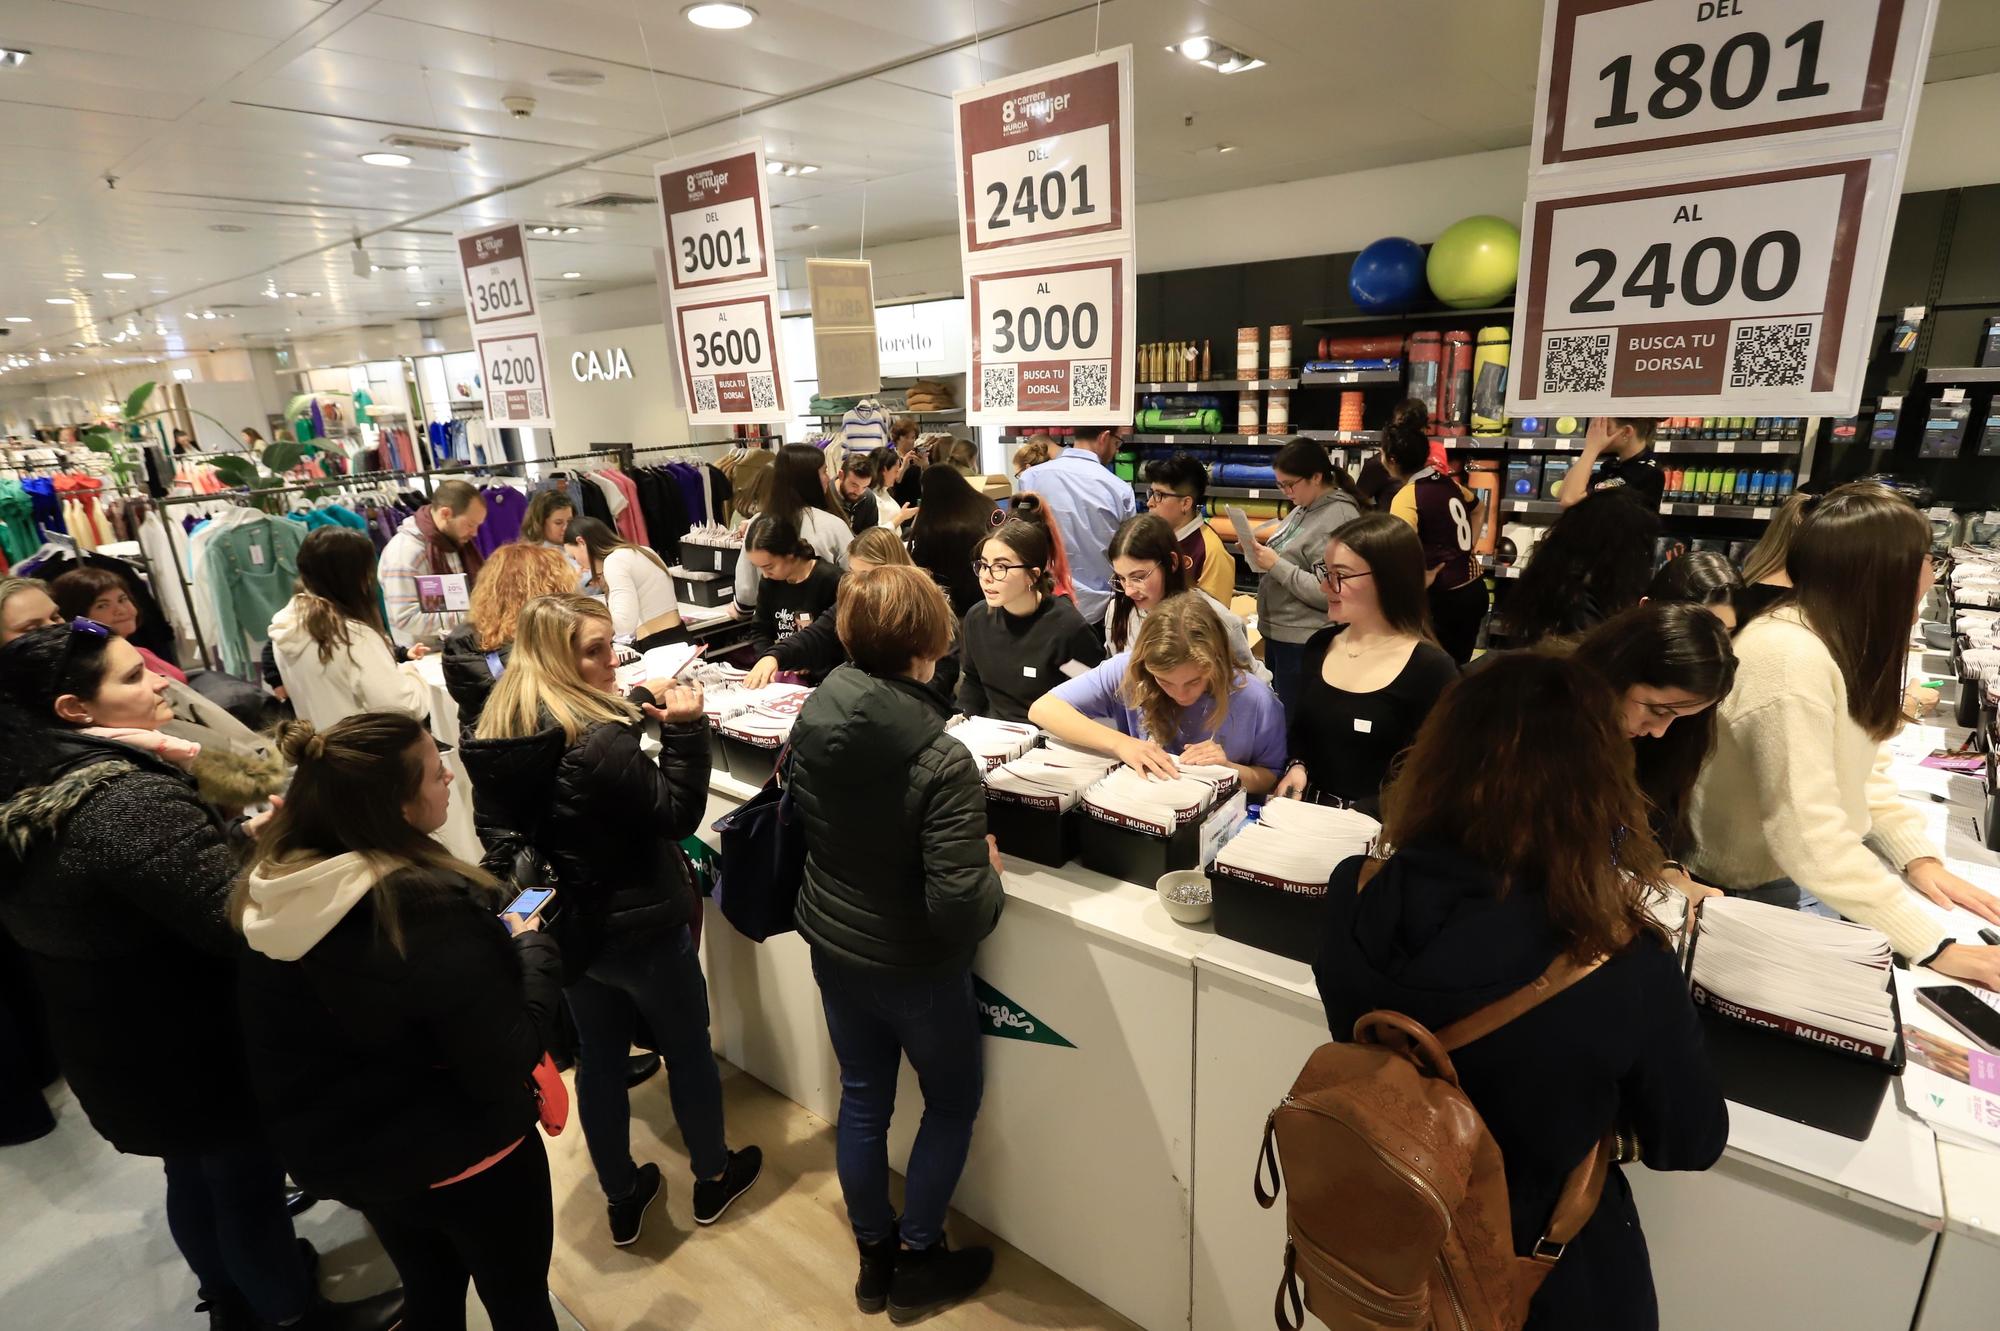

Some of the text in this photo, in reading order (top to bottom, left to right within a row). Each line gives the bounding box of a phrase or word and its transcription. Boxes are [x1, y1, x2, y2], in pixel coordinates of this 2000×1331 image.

[1697, 0, 1743, 22] DEL
[1594, 20, 1830, 129] 1801
[1017, 91, 1046, 106] carrera
[1026, 93, 1071, 123] mujer
[1003, 120, 1028, 132] MURCIA
[1028, 148, 1049, 162] DEL
[701, 172, 729, 194] mujer
[986, 164, 1096, 230] 2401
[705, 212, 719, 223] DEL
[1673, 204, 1703, 223] AL
[681, 226, 751, 273] 3001
[1569, 230, 1801, 314] 2400
[477, 278, 523, 312] 3601
[1036, 282, 1051, 294] AL
[718, 312, 727, 322] AL
[992, 301, 1099, 354] 3000
[693, 327, 761, 368] 3600
[1629, 333, 1716, 351] BUSCA TU
[491, 356, 535, 385] 4200
[571, 347, 633, 382] CAJA
[1635, 357, 1704, 372] DORSAL
[719, 379, 746, 388] BUSCA TU
[1023, 369, 1065, 380] BUSCA TU
[723, 391, 745, 399] DORSAL
[1027, 385, 1060, 394] DORSAL
[1448, 497, 1472, 552] 8
[1021, 796, 1055, 808] MURCIA
[1125, 818, 1162, 834] MURCIA
[1231, 868, 1255, 878] carrera
[1283, 882, 1328, 895] MURCIA
[1710, 996, 1747, 1014] carrera
[979, 1000, 1035, 1034] nglés
[1795, 1025, 1873, 1056] MURCIA
